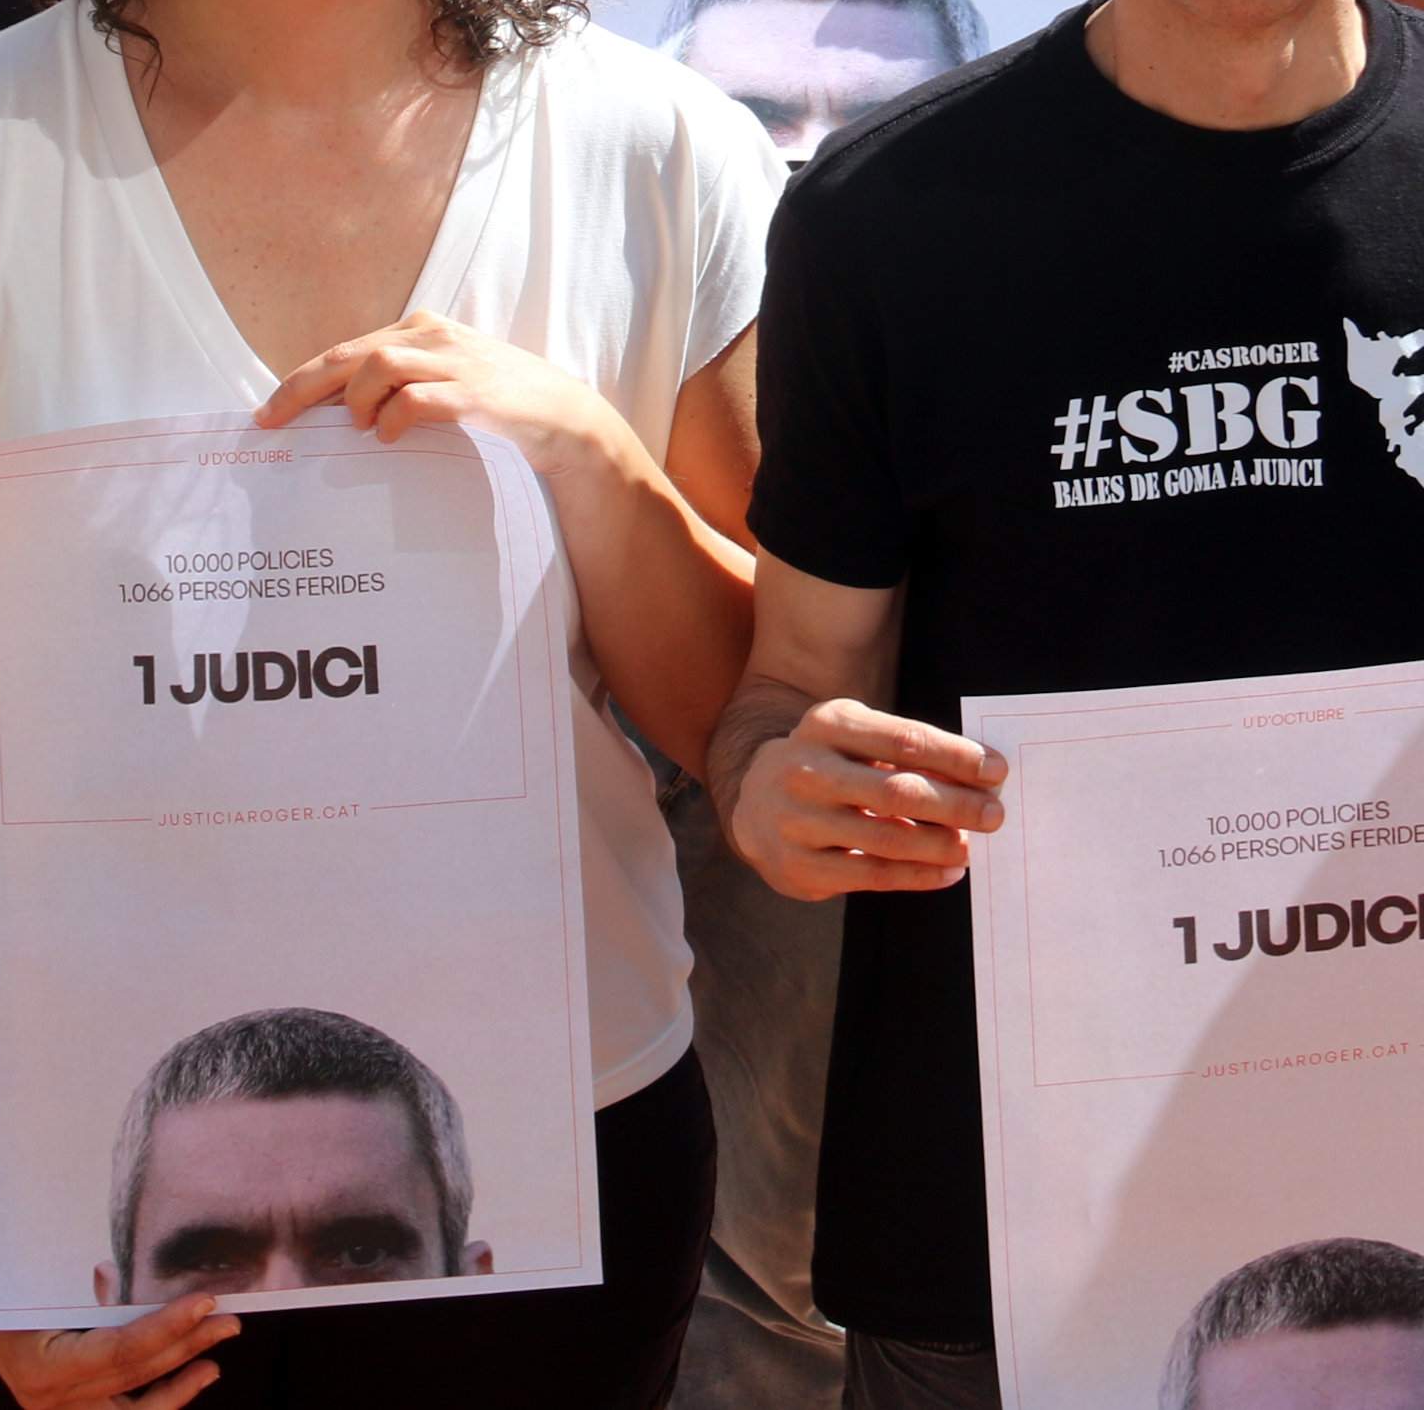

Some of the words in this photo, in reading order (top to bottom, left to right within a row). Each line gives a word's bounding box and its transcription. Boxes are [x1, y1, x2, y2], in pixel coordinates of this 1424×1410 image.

[1168, 341, 1319, 373] #CASROGER
[1050, 376, 1321, 470] #SBG
[199, 453, 209, 465] U
[212, 450, 293, 465] D'OCTUBRE
[1053, 475, 1125, 509] BALES
[1129, 472, 1160, 501] DE
[1165, 464, 1227, 497] GOMA
[1230, 461, 1247, 488] A
[1250, 458, 1323, 487] JUDICI
[165, 553, 233, 573] 10.000
[238, 548, 334, 571] POLICIES
[119, 583, 174, 602] 1.066
[179, 578, 290, 601] PERSONES
[296, 572, 385, 596] FERIDES
[133, 655, 155, 704] 1
[170, 645, 379, 704] JUDICI
[1243, 717, 1253, 729] U
[1257, 708, 1345, 728] D'OCTUBRE
[158, 804, 360, 826] JUSTICIAROGER.CAT
[1207, 812, 1281, 835] 10.000
[1286, 800, 1390, 827] POLICIES
[1158, 845, 1216, 868] 1.066
[1222, 832, 1345, 861] PERSONES
[1173, 916, 1197, 964] 1
[1201, 1042, 1409, 1078] JUSTICIAROGER.CAT
